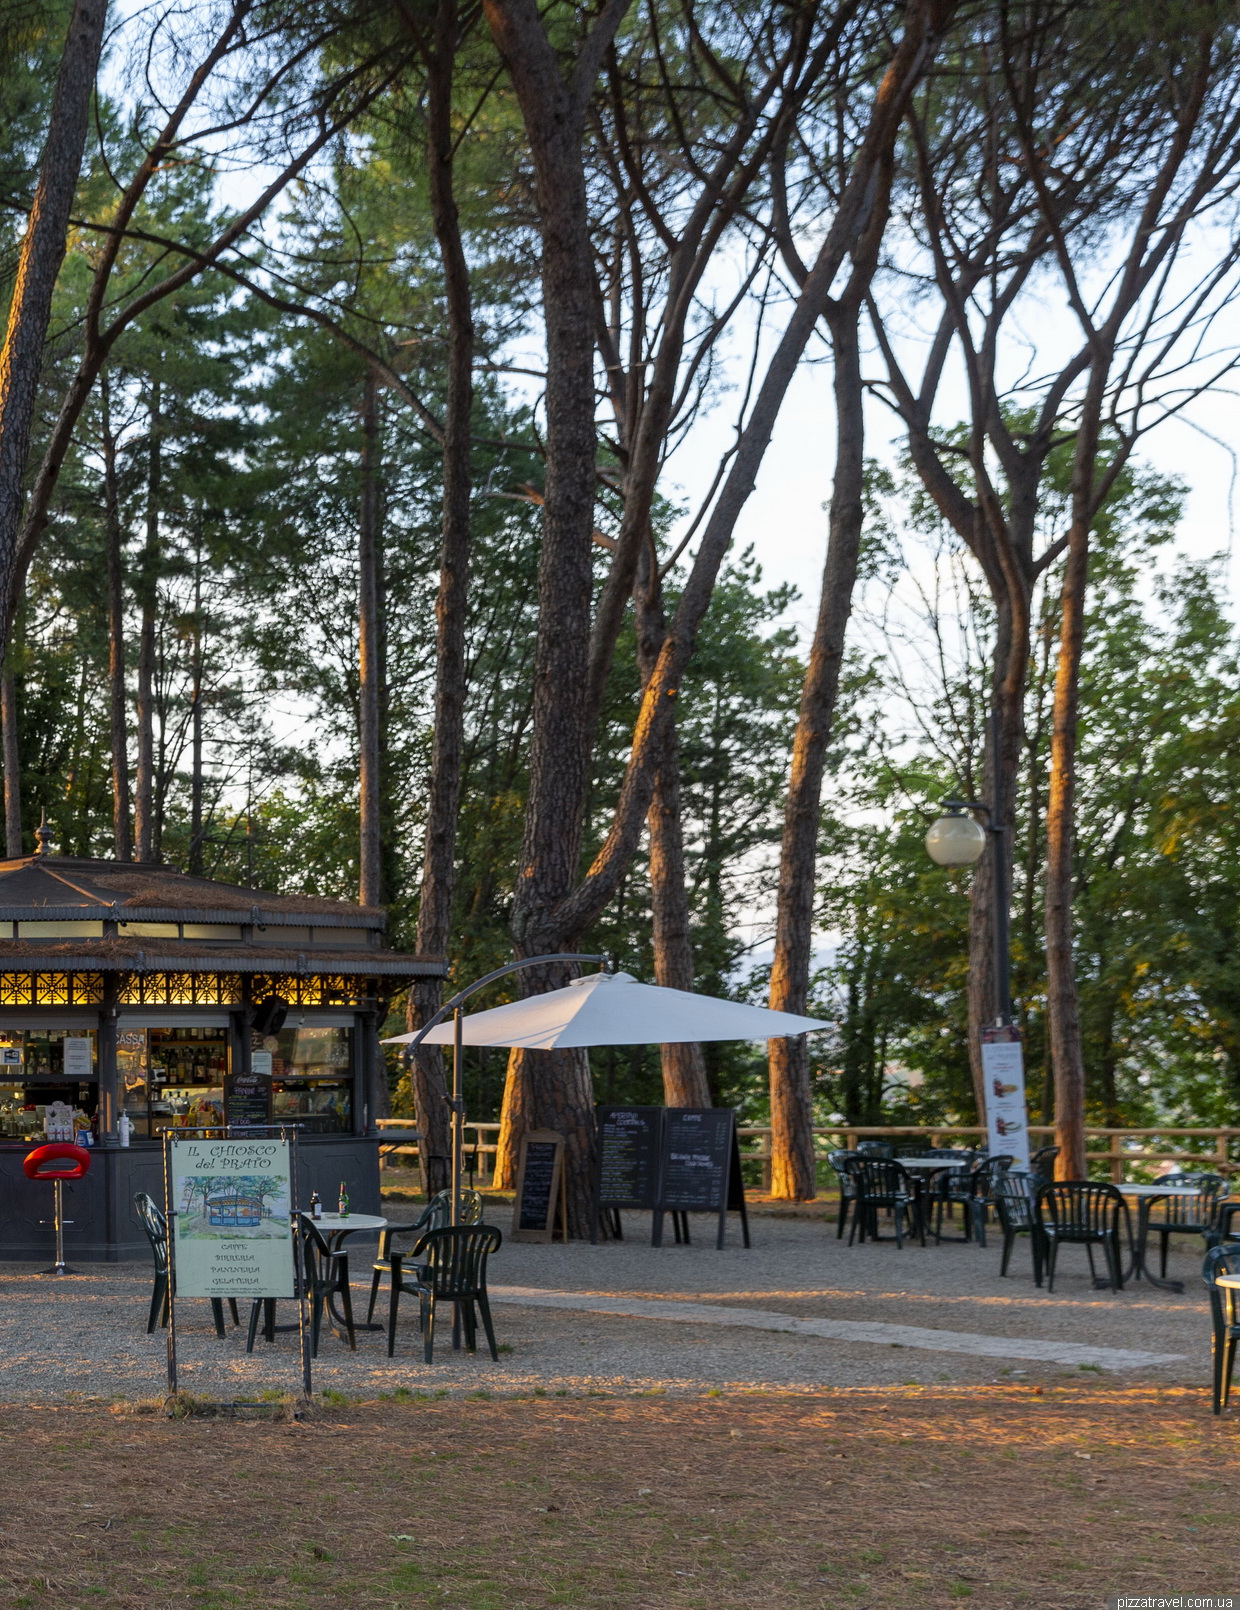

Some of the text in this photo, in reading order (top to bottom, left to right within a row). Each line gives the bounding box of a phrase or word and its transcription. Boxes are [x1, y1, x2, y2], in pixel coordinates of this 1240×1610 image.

[187, 1145, 276, 1158] IL CHIOSCO
[195, 1157, 272, 1170] del PRATO
[212, 1277, 259, 1285] GELATERIA
